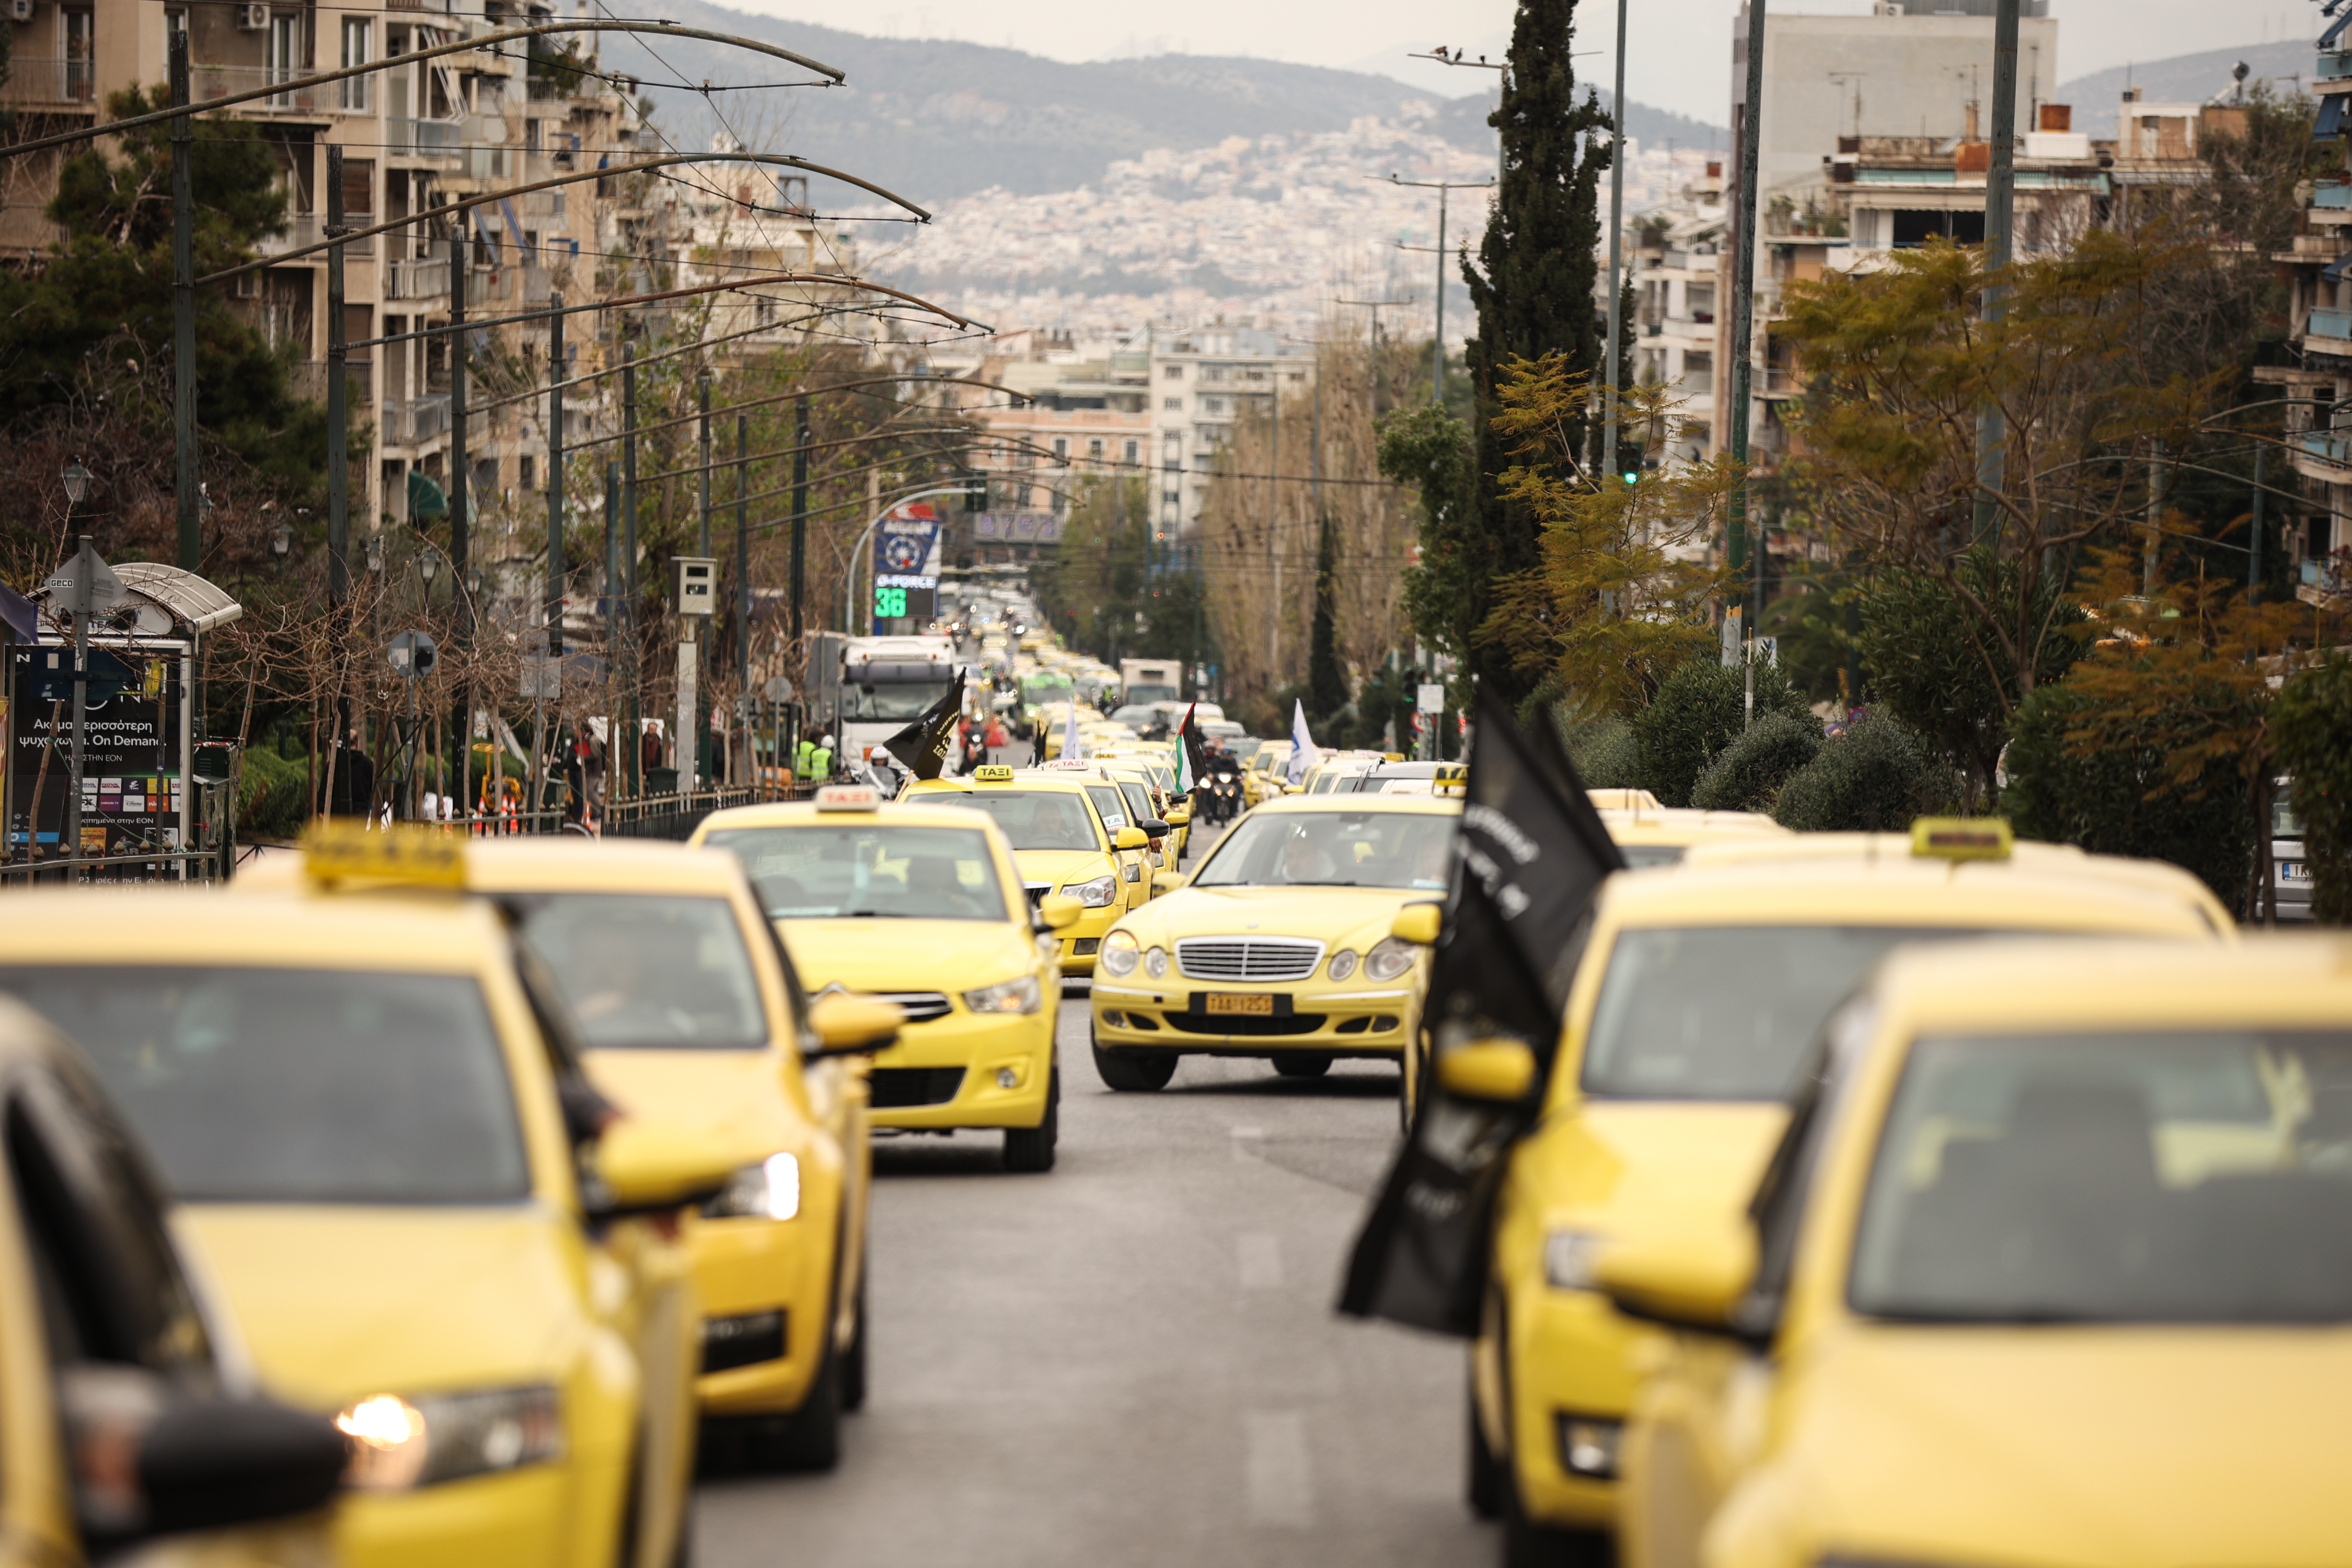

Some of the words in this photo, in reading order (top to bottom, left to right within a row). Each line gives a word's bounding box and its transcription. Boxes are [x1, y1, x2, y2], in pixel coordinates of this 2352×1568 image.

[33, 718, 73, 733] Ακμα
[84, 719, 153, 733] ερισσότερη
[93, 735, 110, 746] On
[114, 735, 167, 746] Deman.
[1444, 768, 1468, 779] ΤΑ
[823, 792, 871, 803] ΤΑΞΙ
[2295, 865, 2311, 877] IK
[85, 875, 112, 884] Σιρές
